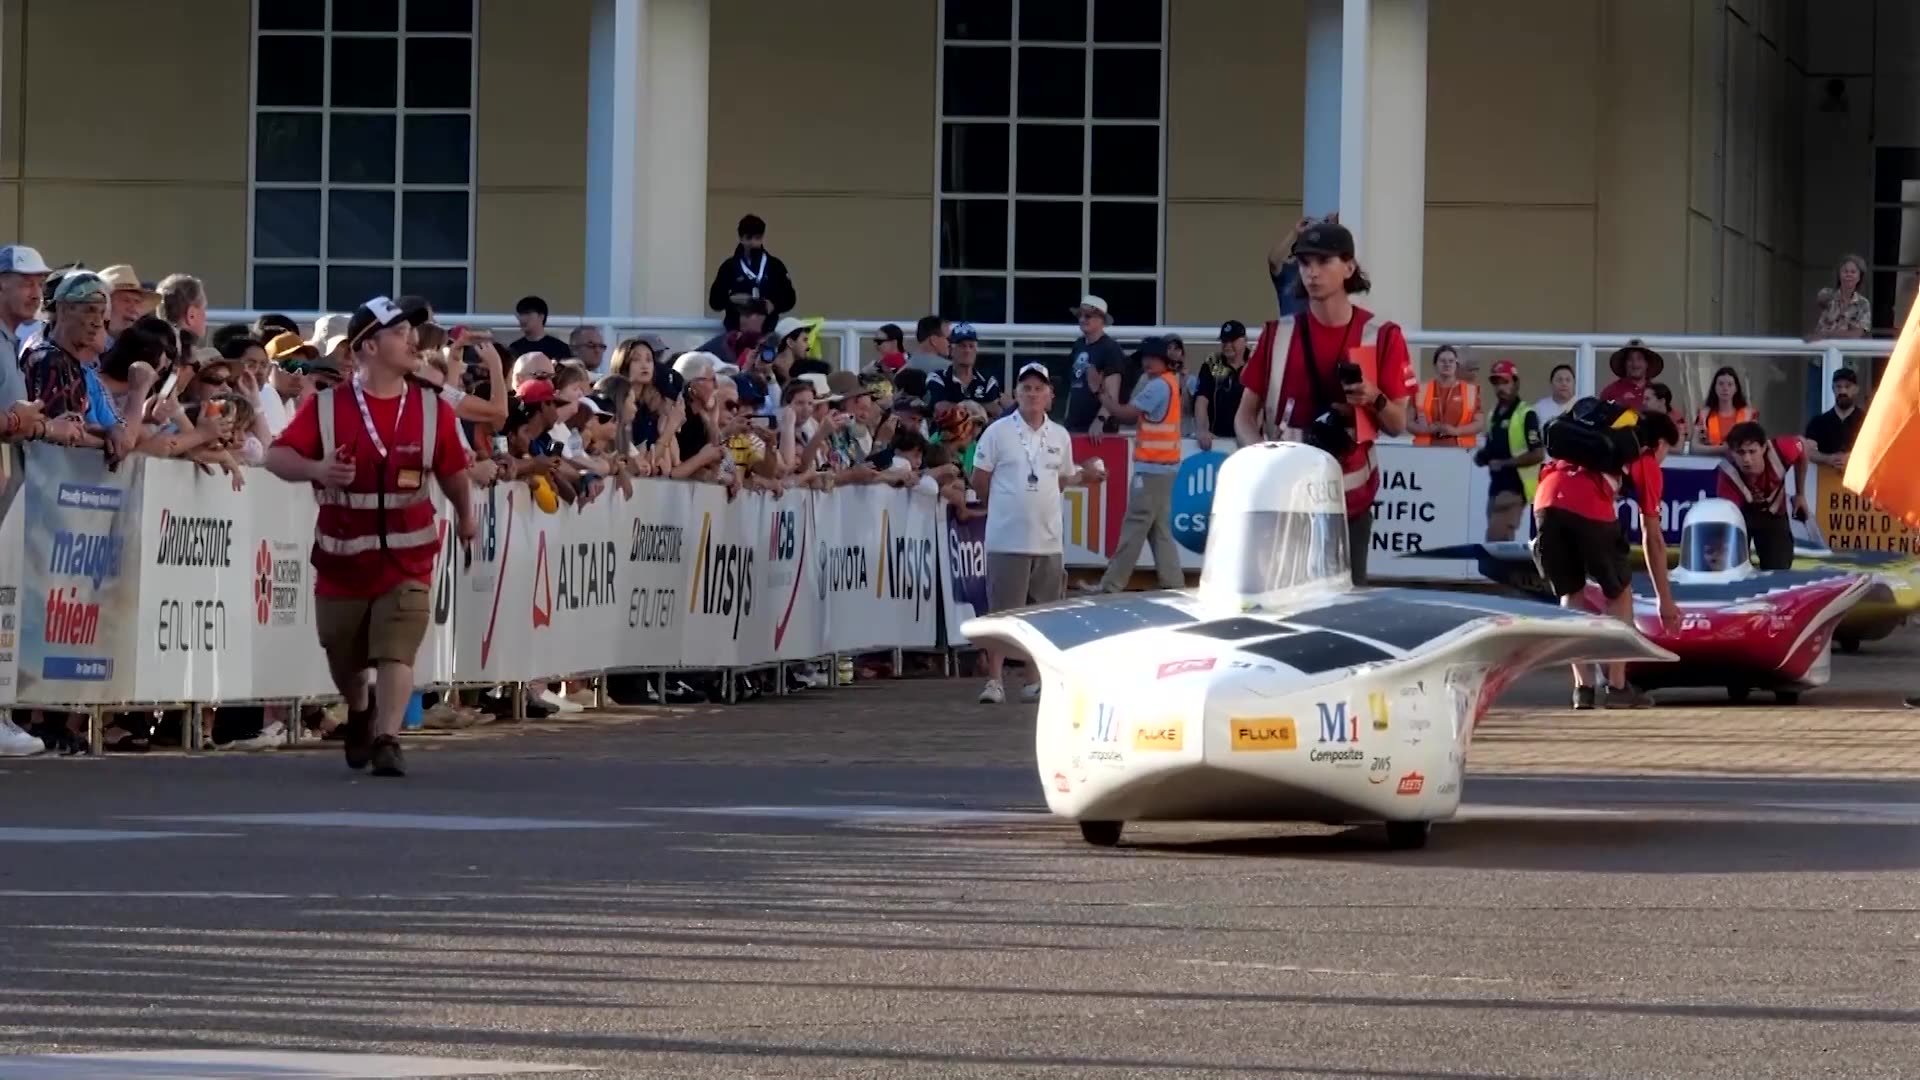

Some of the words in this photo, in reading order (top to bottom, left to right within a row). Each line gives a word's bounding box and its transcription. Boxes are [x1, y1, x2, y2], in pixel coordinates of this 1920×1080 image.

[1383, 471, 1422, 490] IAL
[1372, 501, 1435, 522] TIFIC
[1829, 513, 1891, 534] WORLD
[157, 508, 233, 568] BRIDGESTONE
[1372, 532, 1422, 552] NER
[1828, 535, 1920, 555] CHALLENG
[556, 541, 616, 611] ALTAIR
[829, 545, 867, 591] TOYOTA
[876, 509, 932, 622] Ansys
[45, 587, 99, 645] thiem
[1316, 701, 1359, 743] M1
[1136, 728, 1177, 741] FLUKE
[1239, 728, 1289, 741] FLUKE
[1310, 749, 1364, 763] Composites
